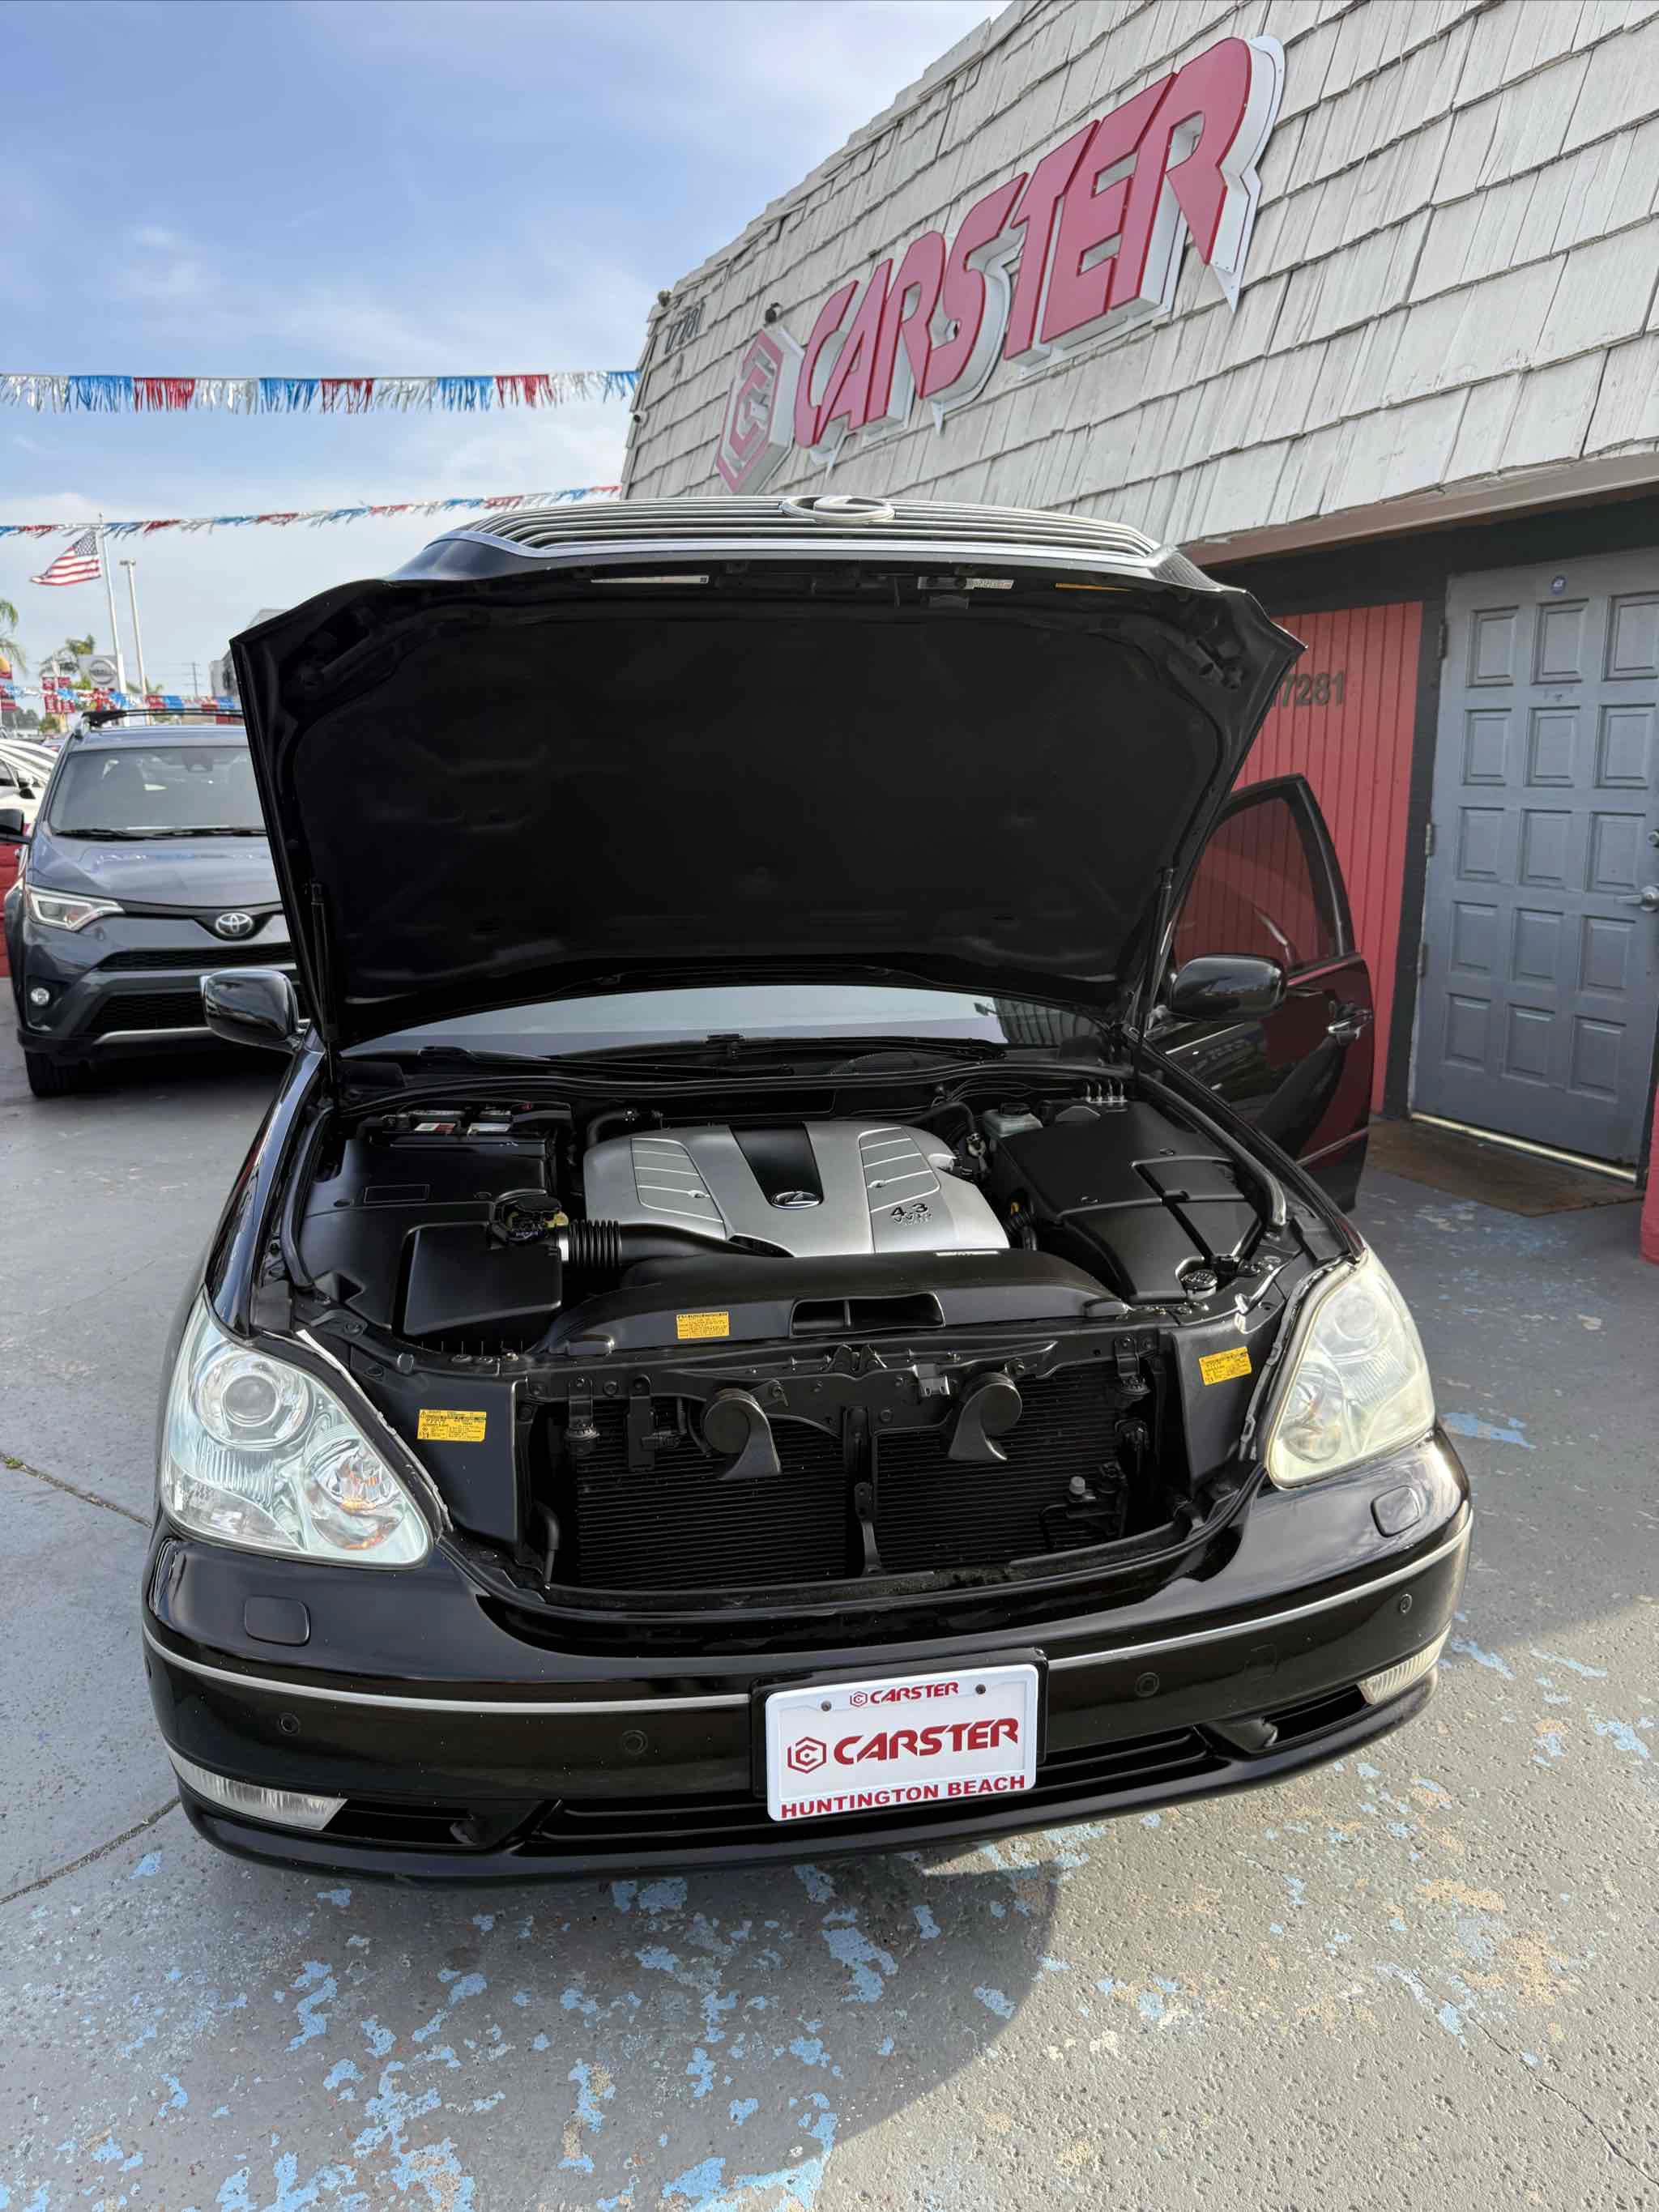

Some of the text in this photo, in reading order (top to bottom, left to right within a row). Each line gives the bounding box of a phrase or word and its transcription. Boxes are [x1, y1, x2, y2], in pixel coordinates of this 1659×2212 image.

[793, 36, 1256, 449] CARSTER
[1272, 671, 1346, 707] 7281
[870, 1681, 959, 1704] CARSTER
[834, 1717, 1019, 1765] CARSTER
[781, 1775, 1026, 1818] HUNTINGTON BEACH
